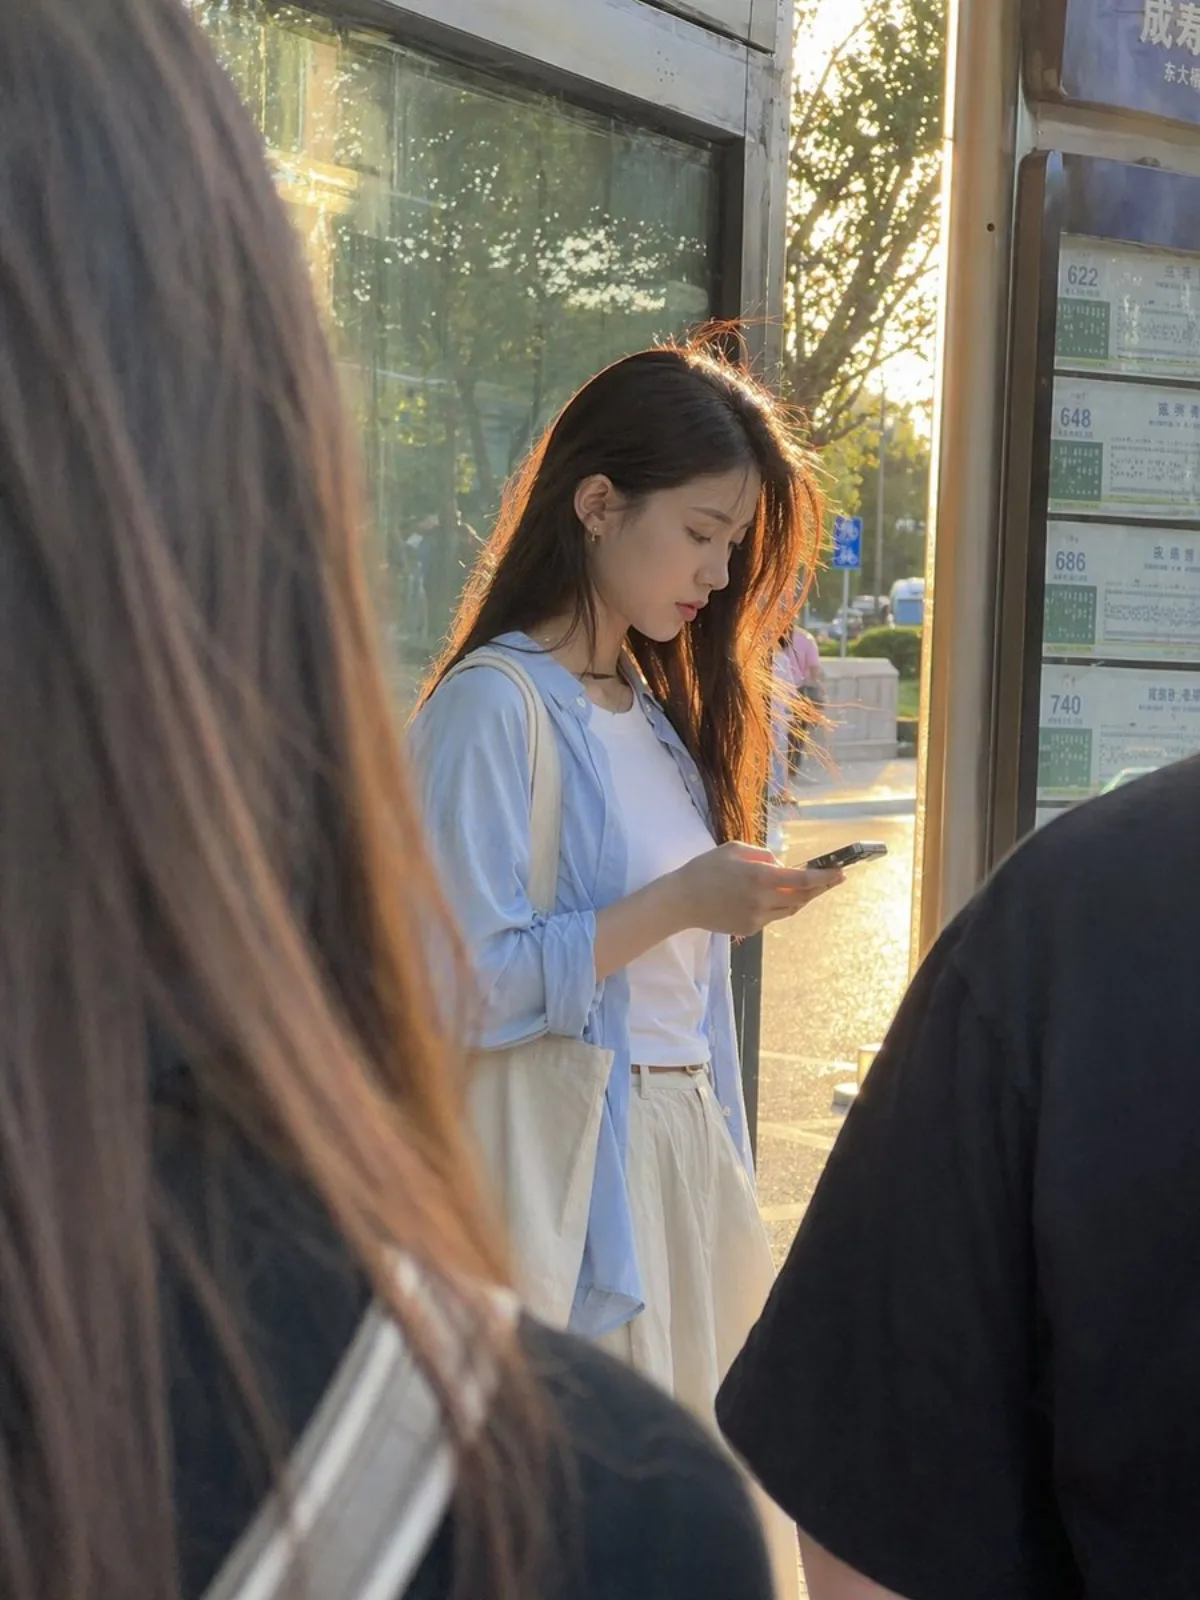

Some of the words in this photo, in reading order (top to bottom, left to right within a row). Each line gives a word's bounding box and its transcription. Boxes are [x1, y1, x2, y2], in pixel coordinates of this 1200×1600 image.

[1067, 265, 1098, 287] 622
[1060, 407, 1092, 429] 648
[1055, 551, 1086, 572] 686
[1051, 694, 1081, 715] 740
